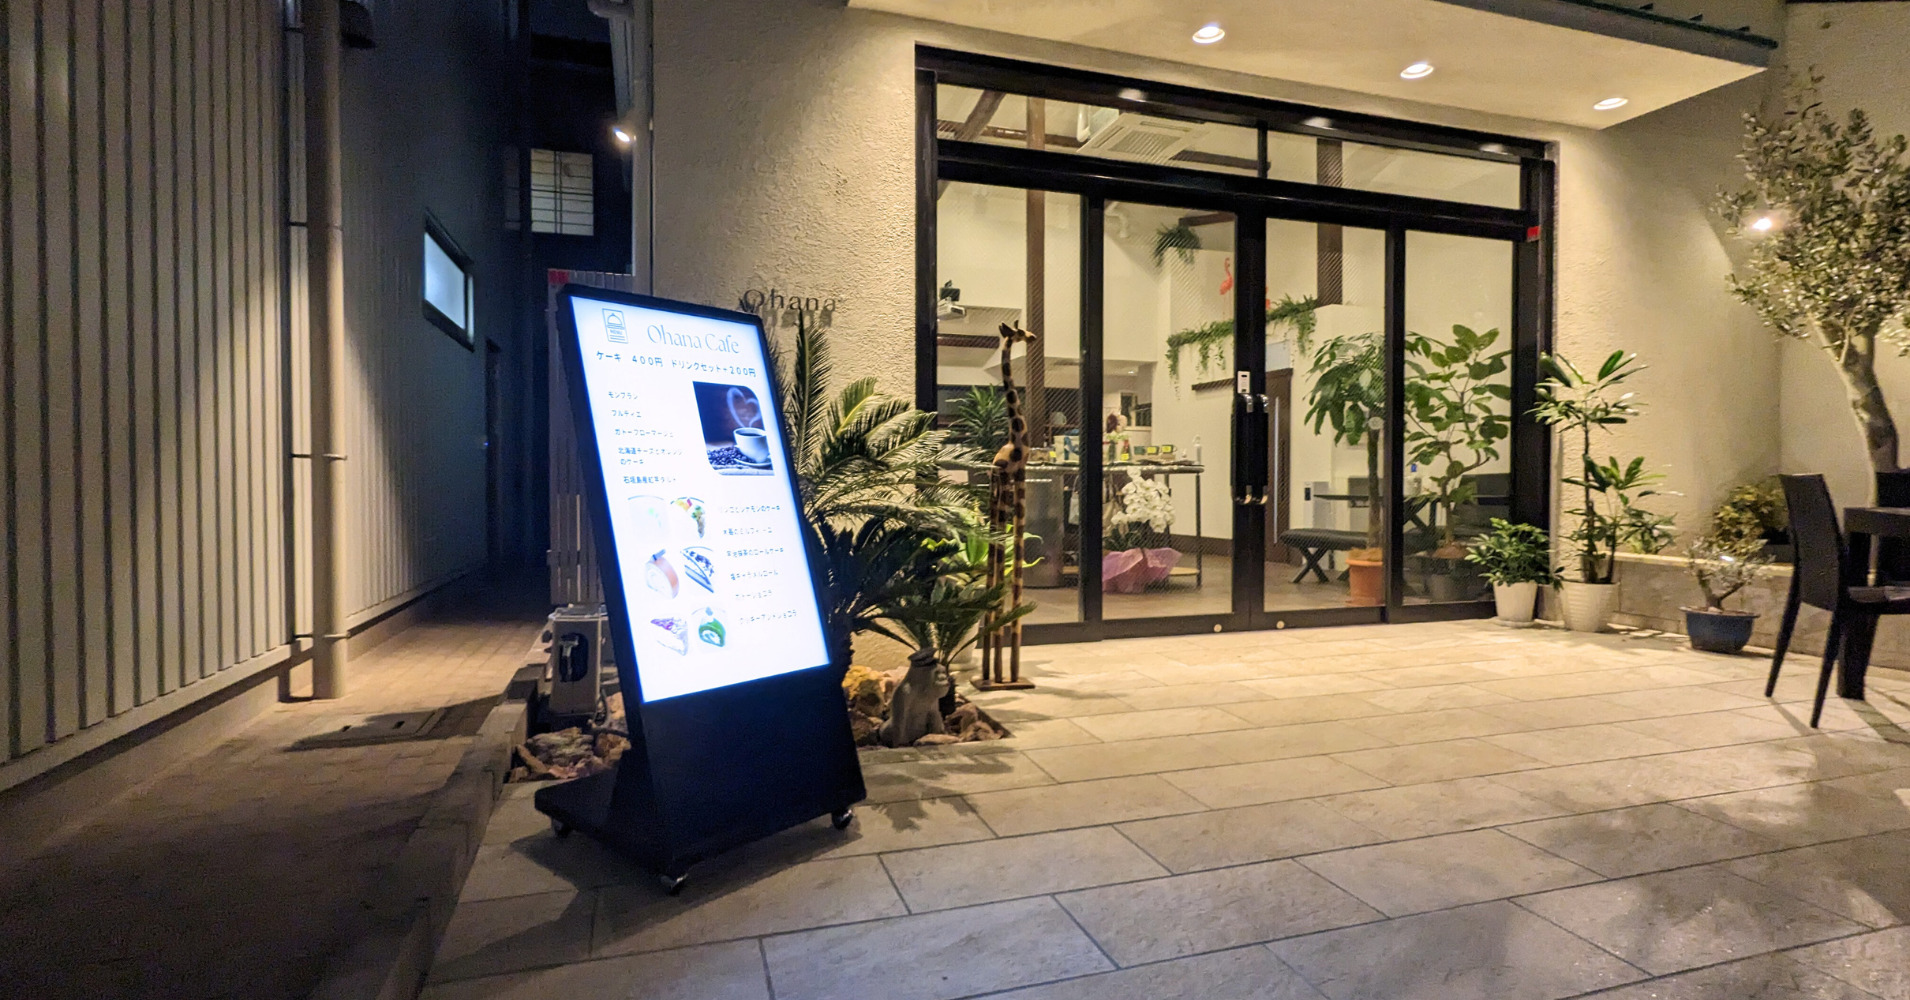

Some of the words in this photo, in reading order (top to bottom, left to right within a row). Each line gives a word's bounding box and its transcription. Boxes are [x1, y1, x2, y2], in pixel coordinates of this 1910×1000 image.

[742, 287, 836, 313] Ohana
[647, 324, 702, 349] Ohana
[704, 333, 740, 354] Cafe
[596, 350, 622, 362] ケーキ
[632, 355, 664, 368] 400円
